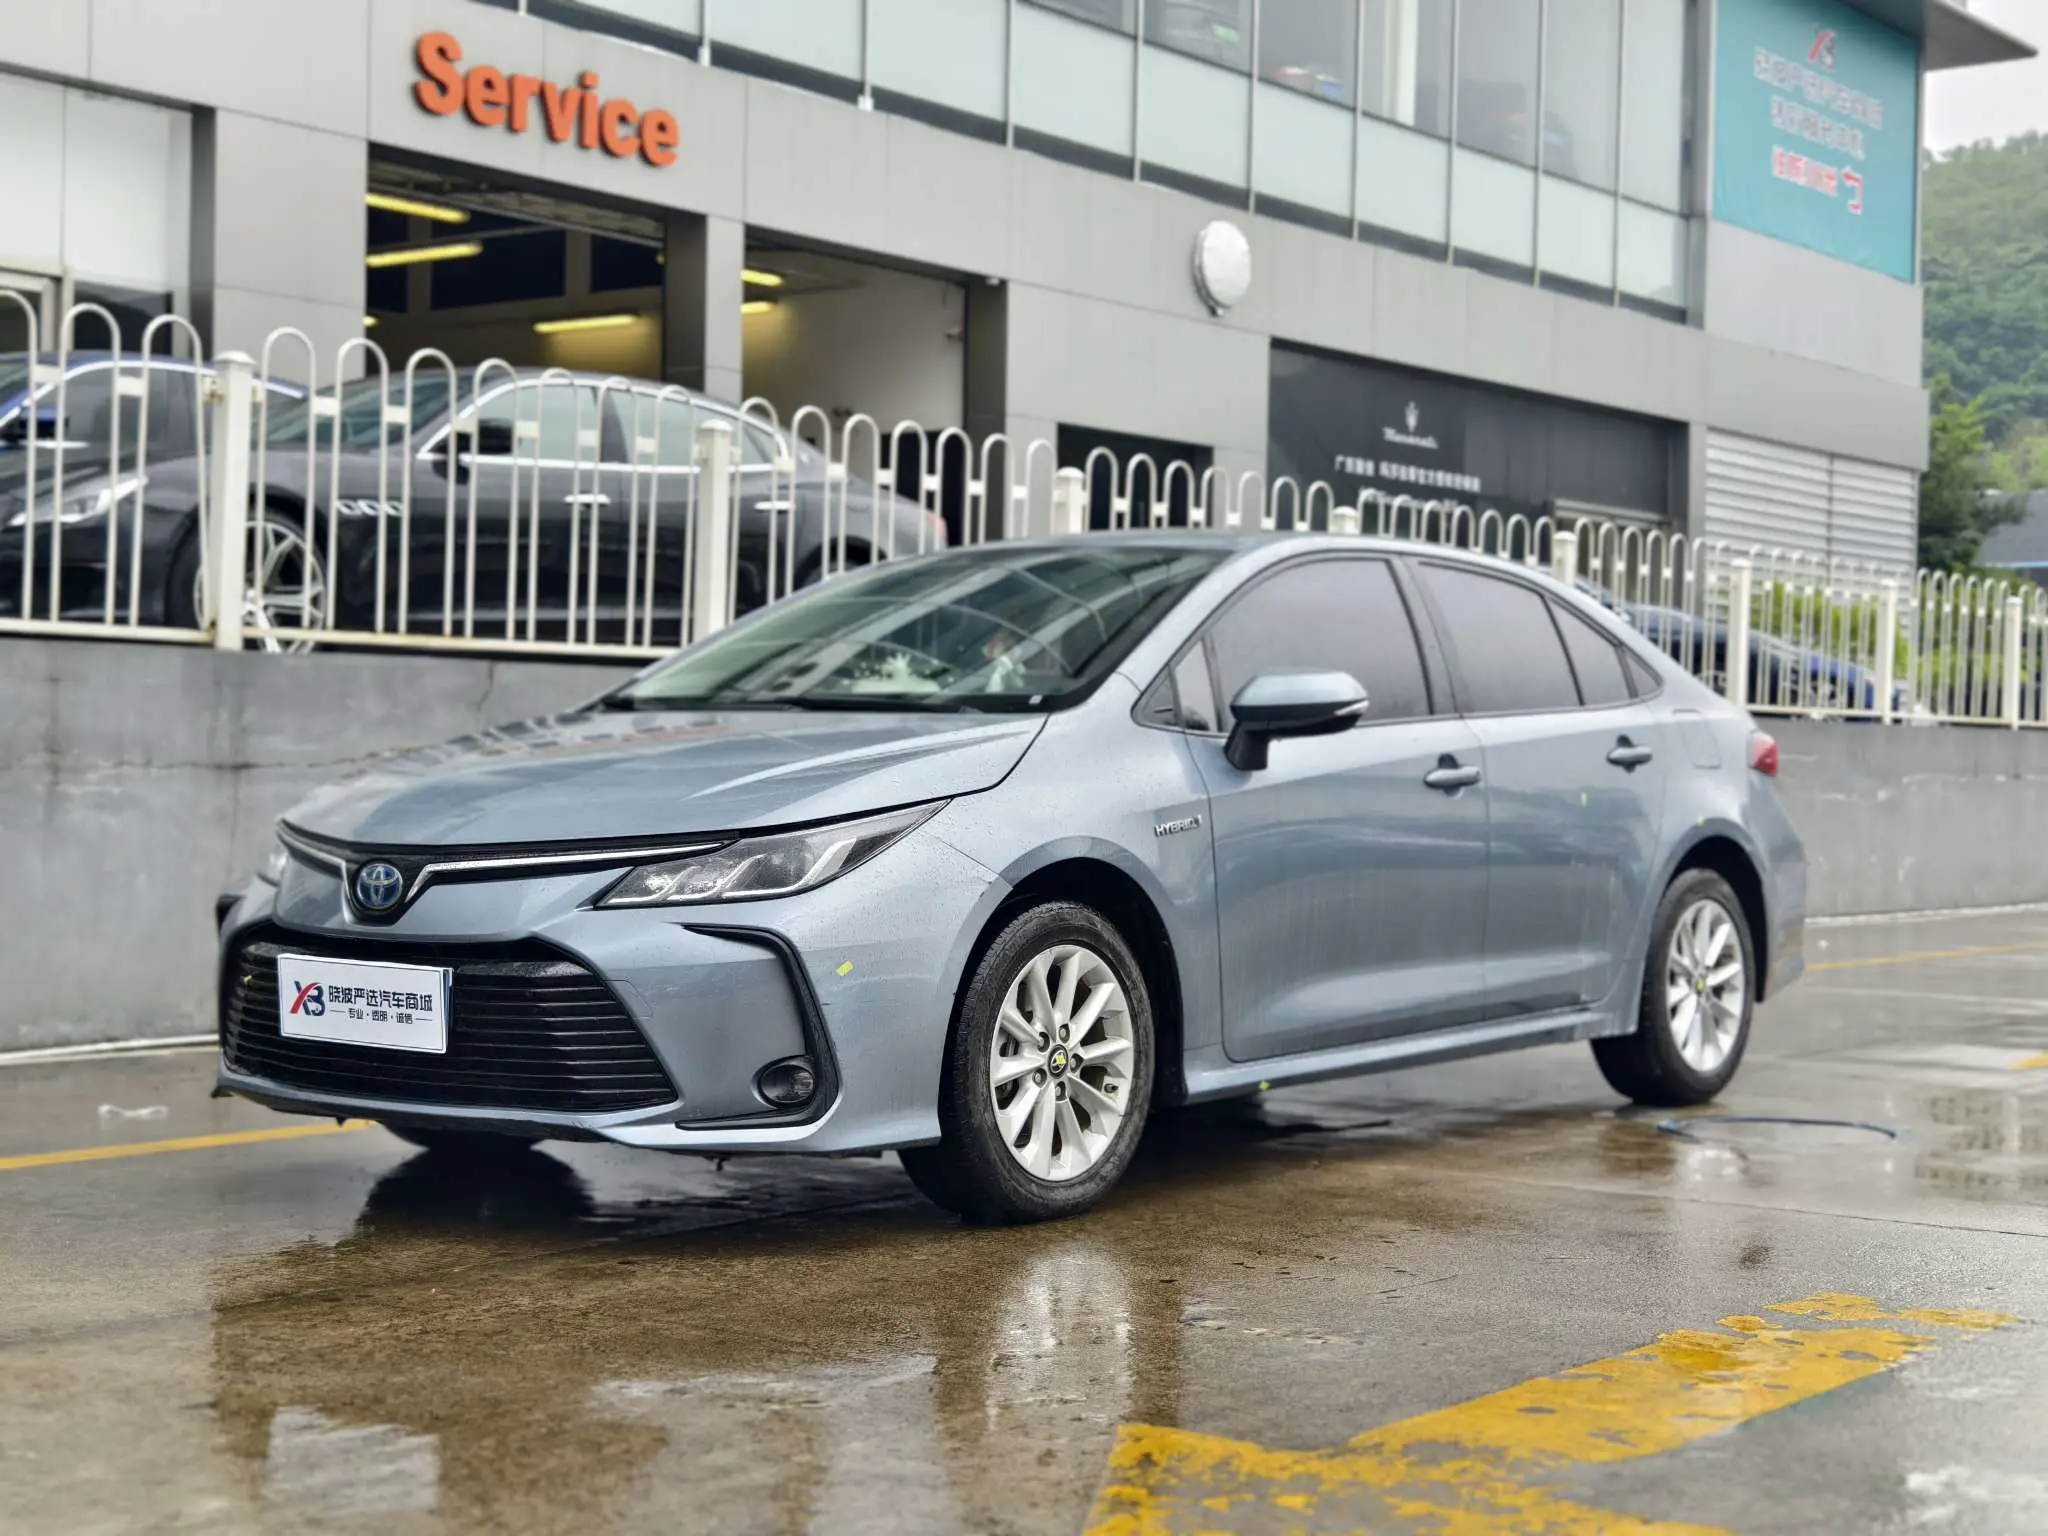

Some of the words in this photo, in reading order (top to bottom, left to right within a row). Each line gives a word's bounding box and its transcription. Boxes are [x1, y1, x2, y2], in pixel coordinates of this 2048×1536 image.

[413, 32, 681, 167] Service
[1154, 816, 1200, 837] HYBRID
[328, 985, 433, 1012] 晓波严选汽车商城
